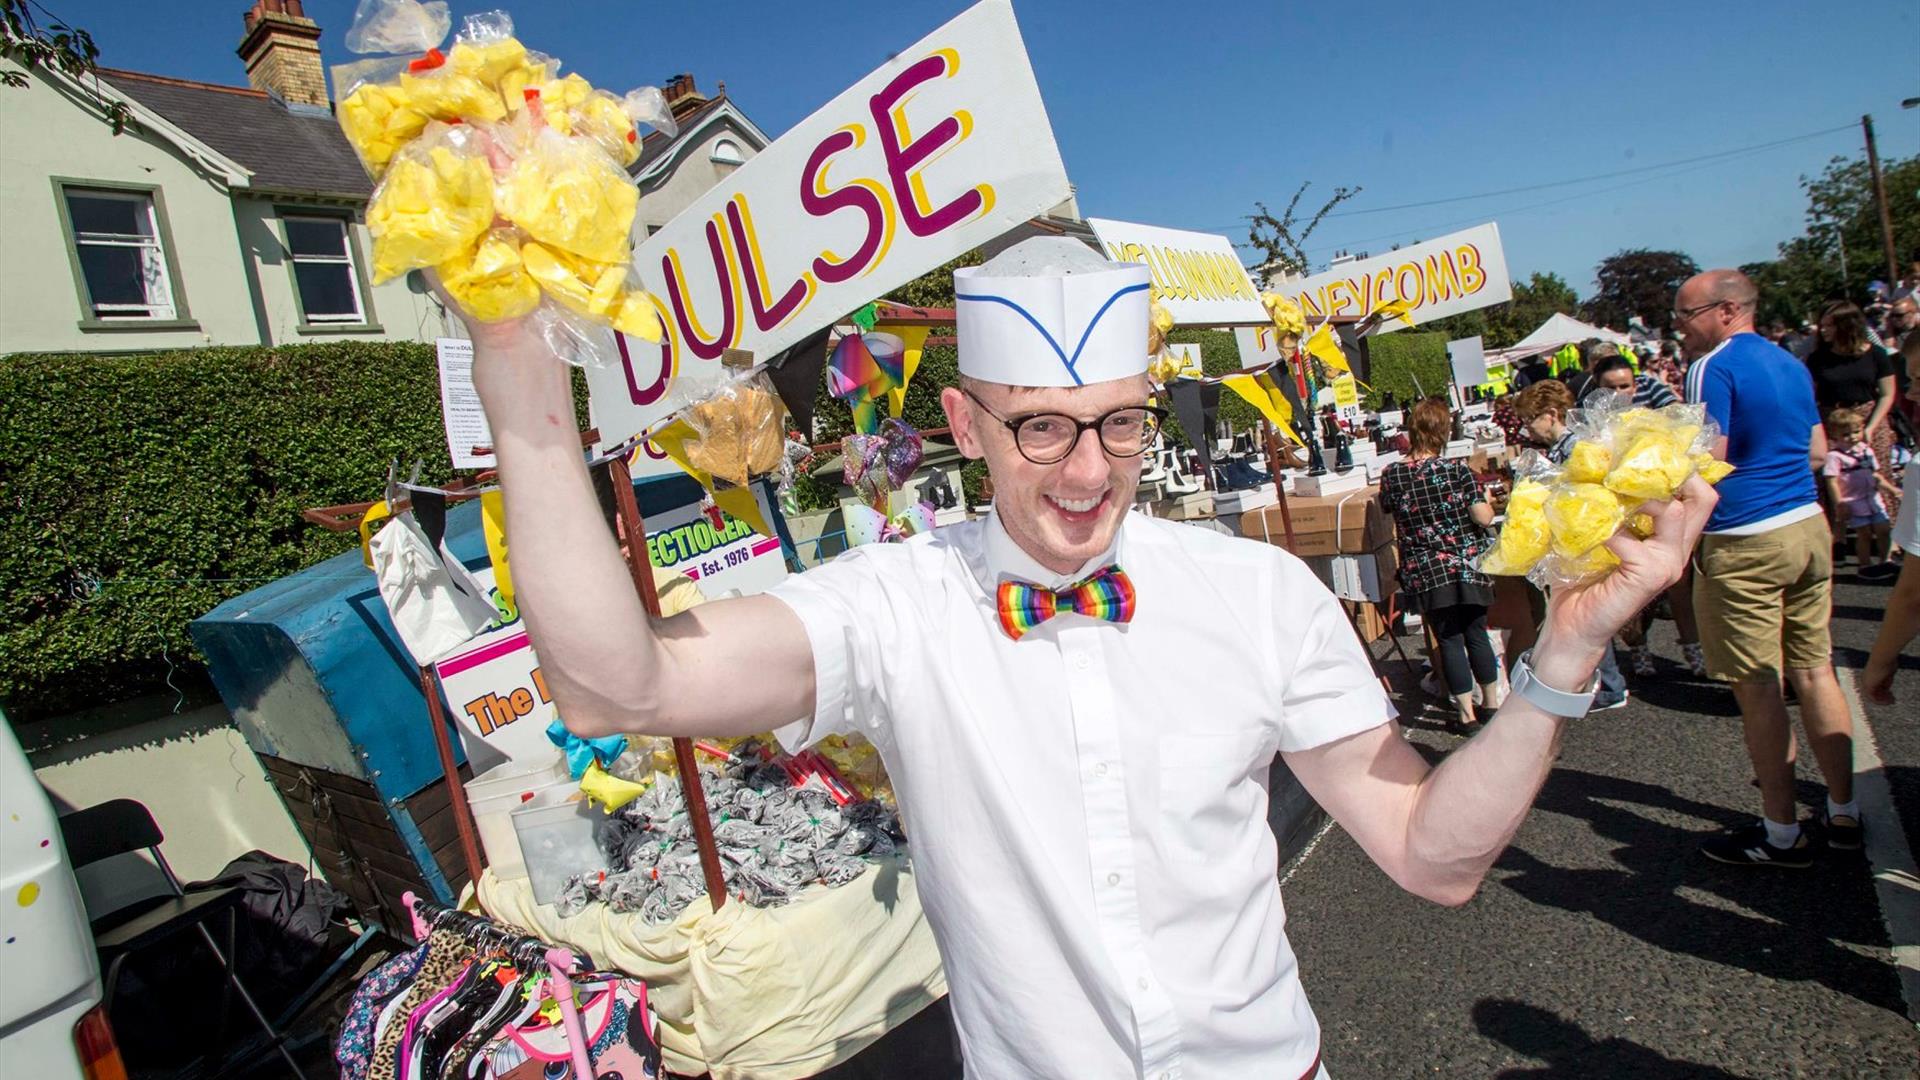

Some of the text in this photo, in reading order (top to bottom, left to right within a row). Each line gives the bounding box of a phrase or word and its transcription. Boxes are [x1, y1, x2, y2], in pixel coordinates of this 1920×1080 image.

[613, 47, 996, 406] DULSE
[1255, 243, 1487, 351] NEYCOMB
[647, 511, 757, 568] ECTIONER
[701, 547, 750, 577] Est. 1976
[463, 687, 534, 738] The
